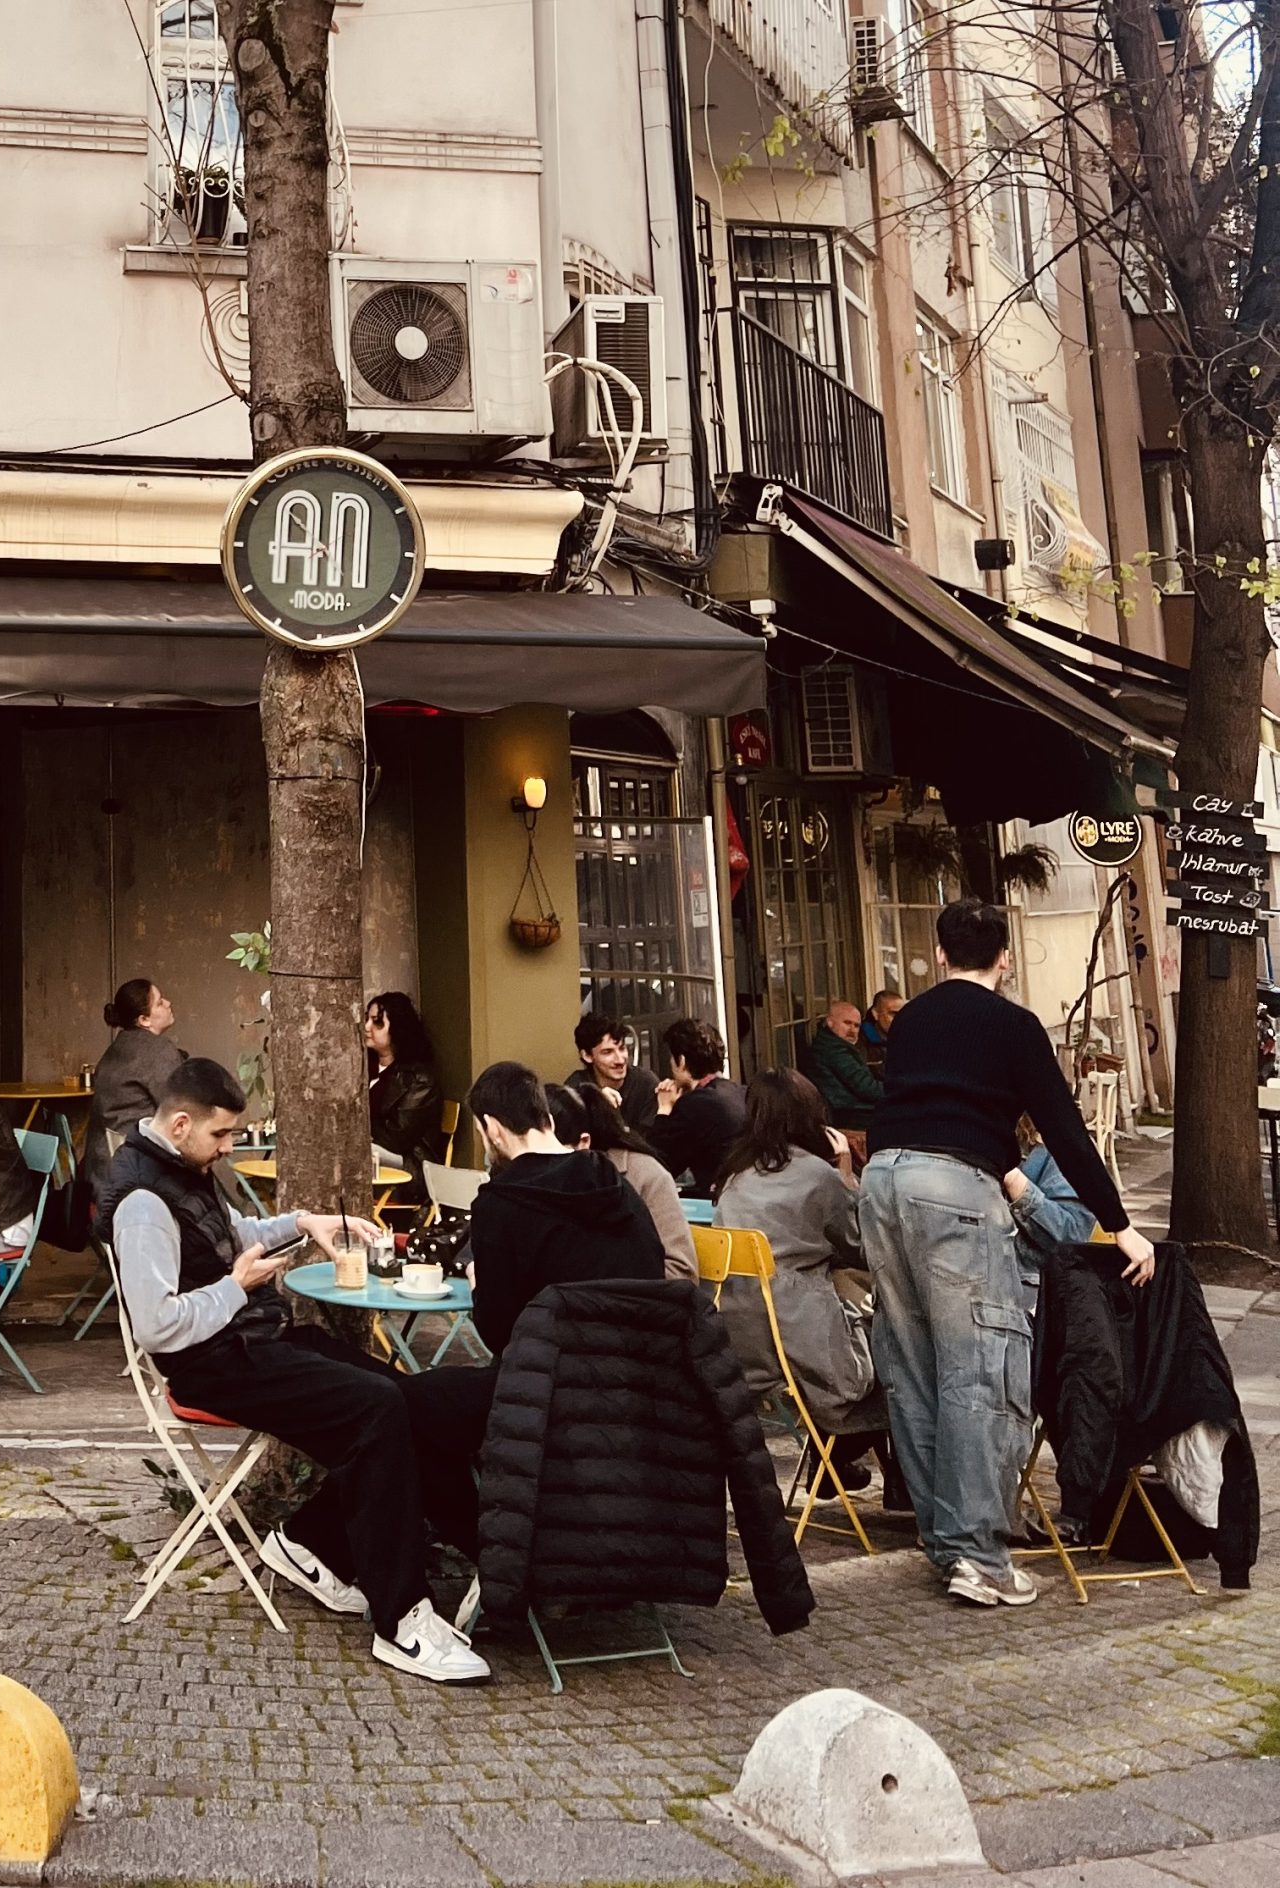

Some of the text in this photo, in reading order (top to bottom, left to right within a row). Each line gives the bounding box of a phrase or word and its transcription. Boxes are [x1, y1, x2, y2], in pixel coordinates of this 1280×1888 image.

[269, 490, 369, 588] AN
[293, 590, 345, 611] MODA
[1192, 795, 1233, 813] Cay
[1100, 821, 1135, 835] LYRE
[1185, 825, 1244, 847] kahve
[1190, 886, 1234, 904] Tost
[1177, 915, 1260, 935] mesrubat
